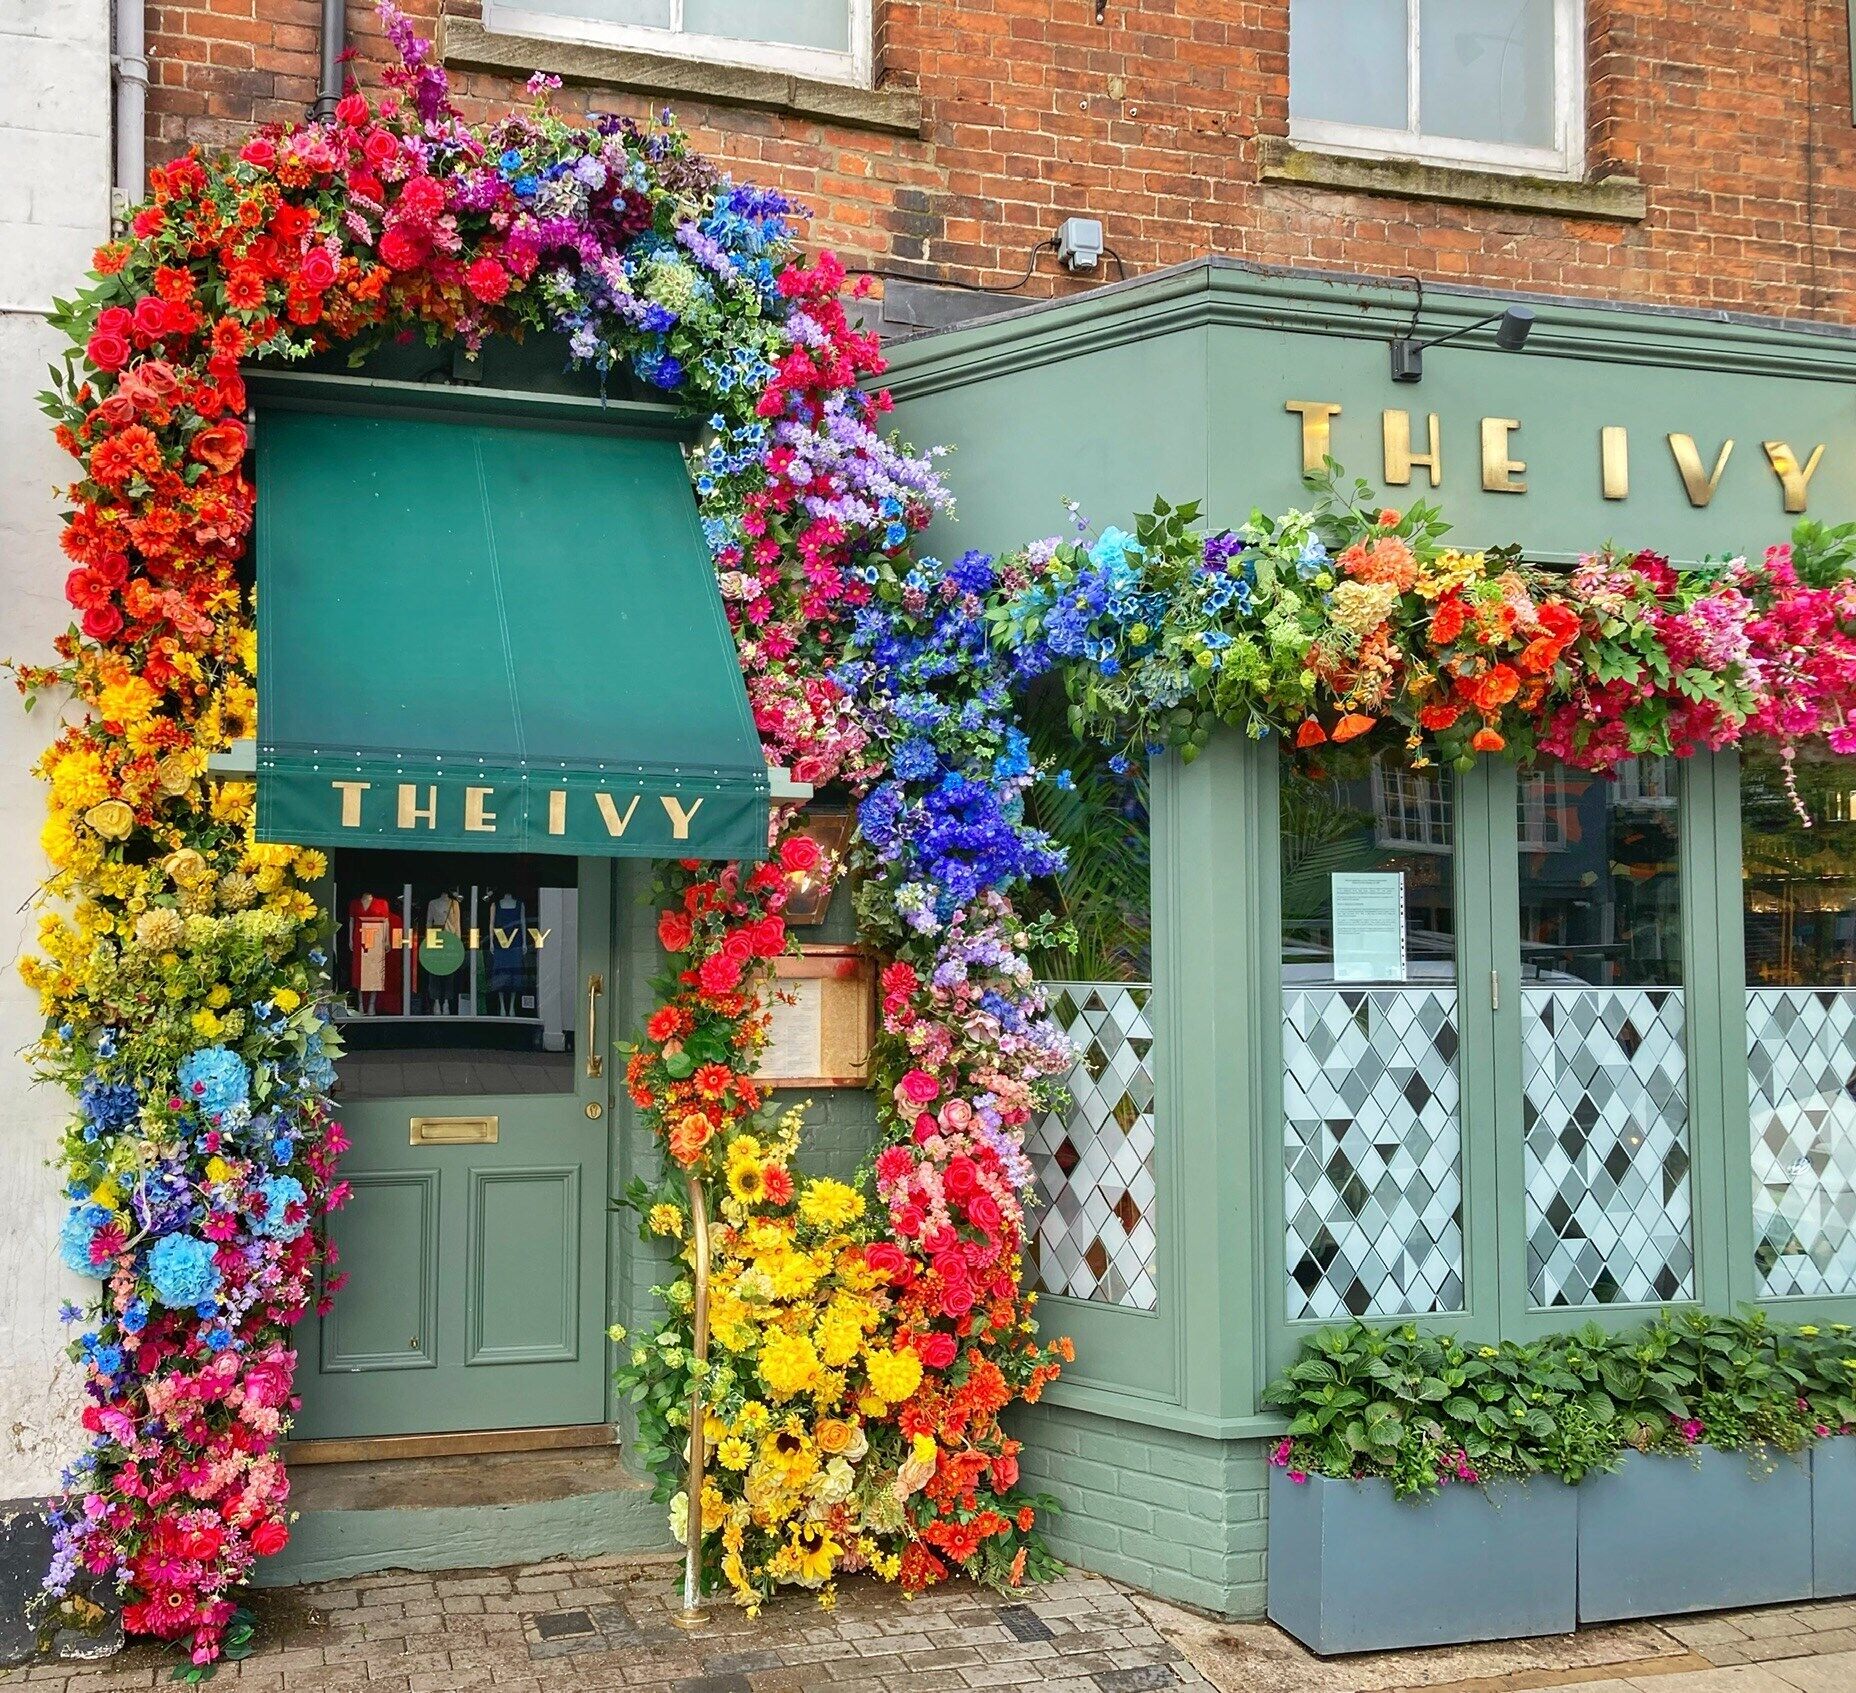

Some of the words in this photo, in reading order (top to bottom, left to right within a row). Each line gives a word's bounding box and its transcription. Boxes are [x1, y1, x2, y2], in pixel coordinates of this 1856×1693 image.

[1286, 400, 1527, 493] THE
[1602, 426, 1825, 512] IVY
[332, 781, 496, 832] THE
[549, 791, 704, 839] IVY
[360, 927, 444, 949] THE
[469, 927, 552, 949] IVY
